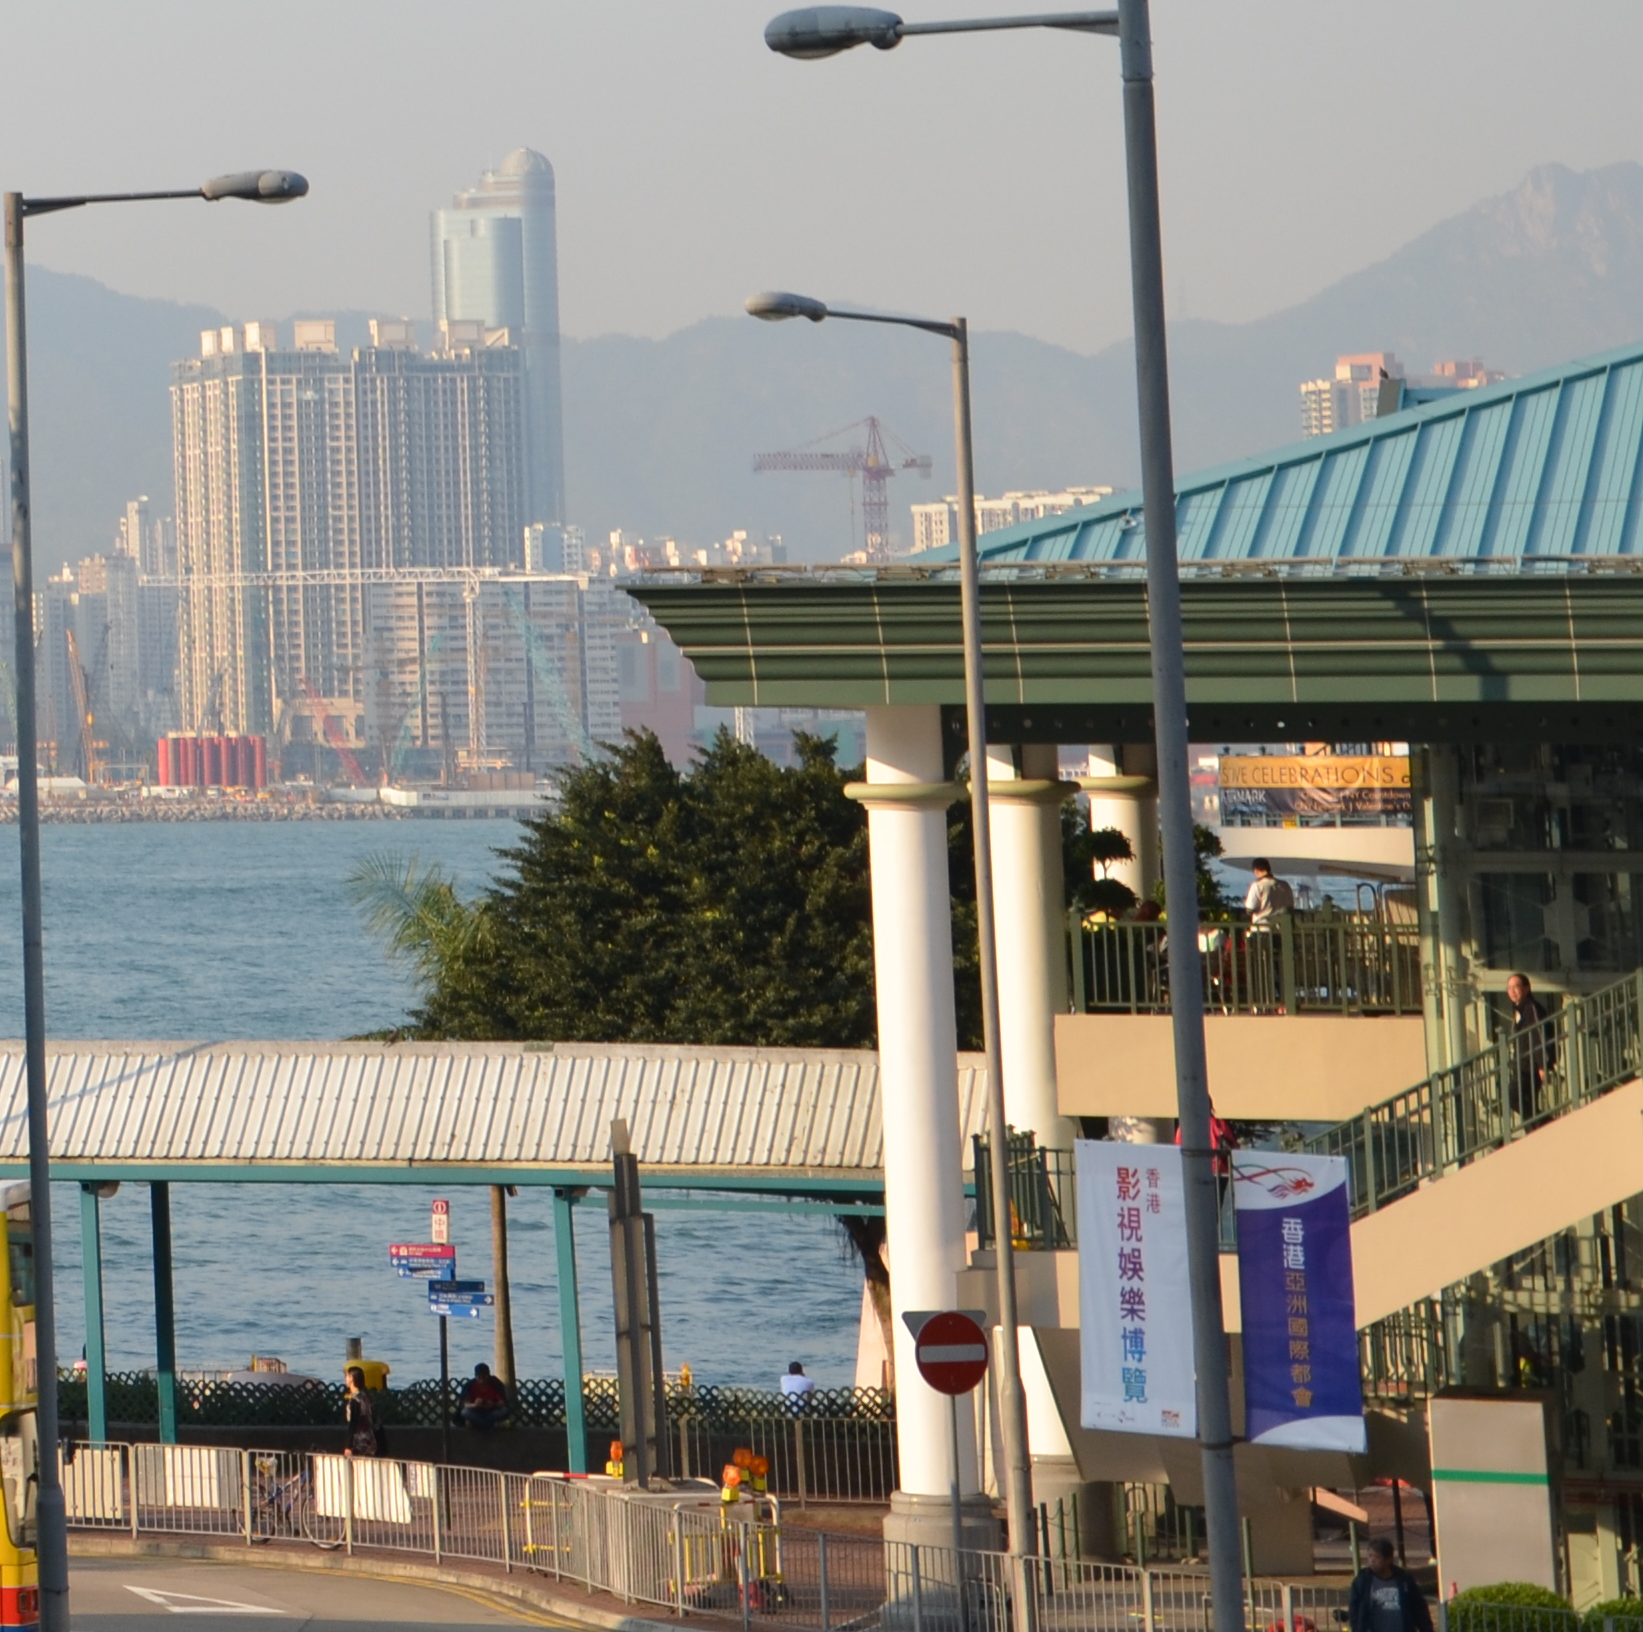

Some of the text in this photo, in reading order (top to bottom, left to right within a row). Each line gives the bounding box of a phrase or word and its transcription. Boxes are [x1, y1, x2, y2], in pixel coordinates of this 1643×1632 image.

[1252, 766, 1394, 786] CELEBRATIONS
[1146, 1168, 1161, 1214] 香港
[1117, 1166, 1147, 1404] 影視娛樂博覽
